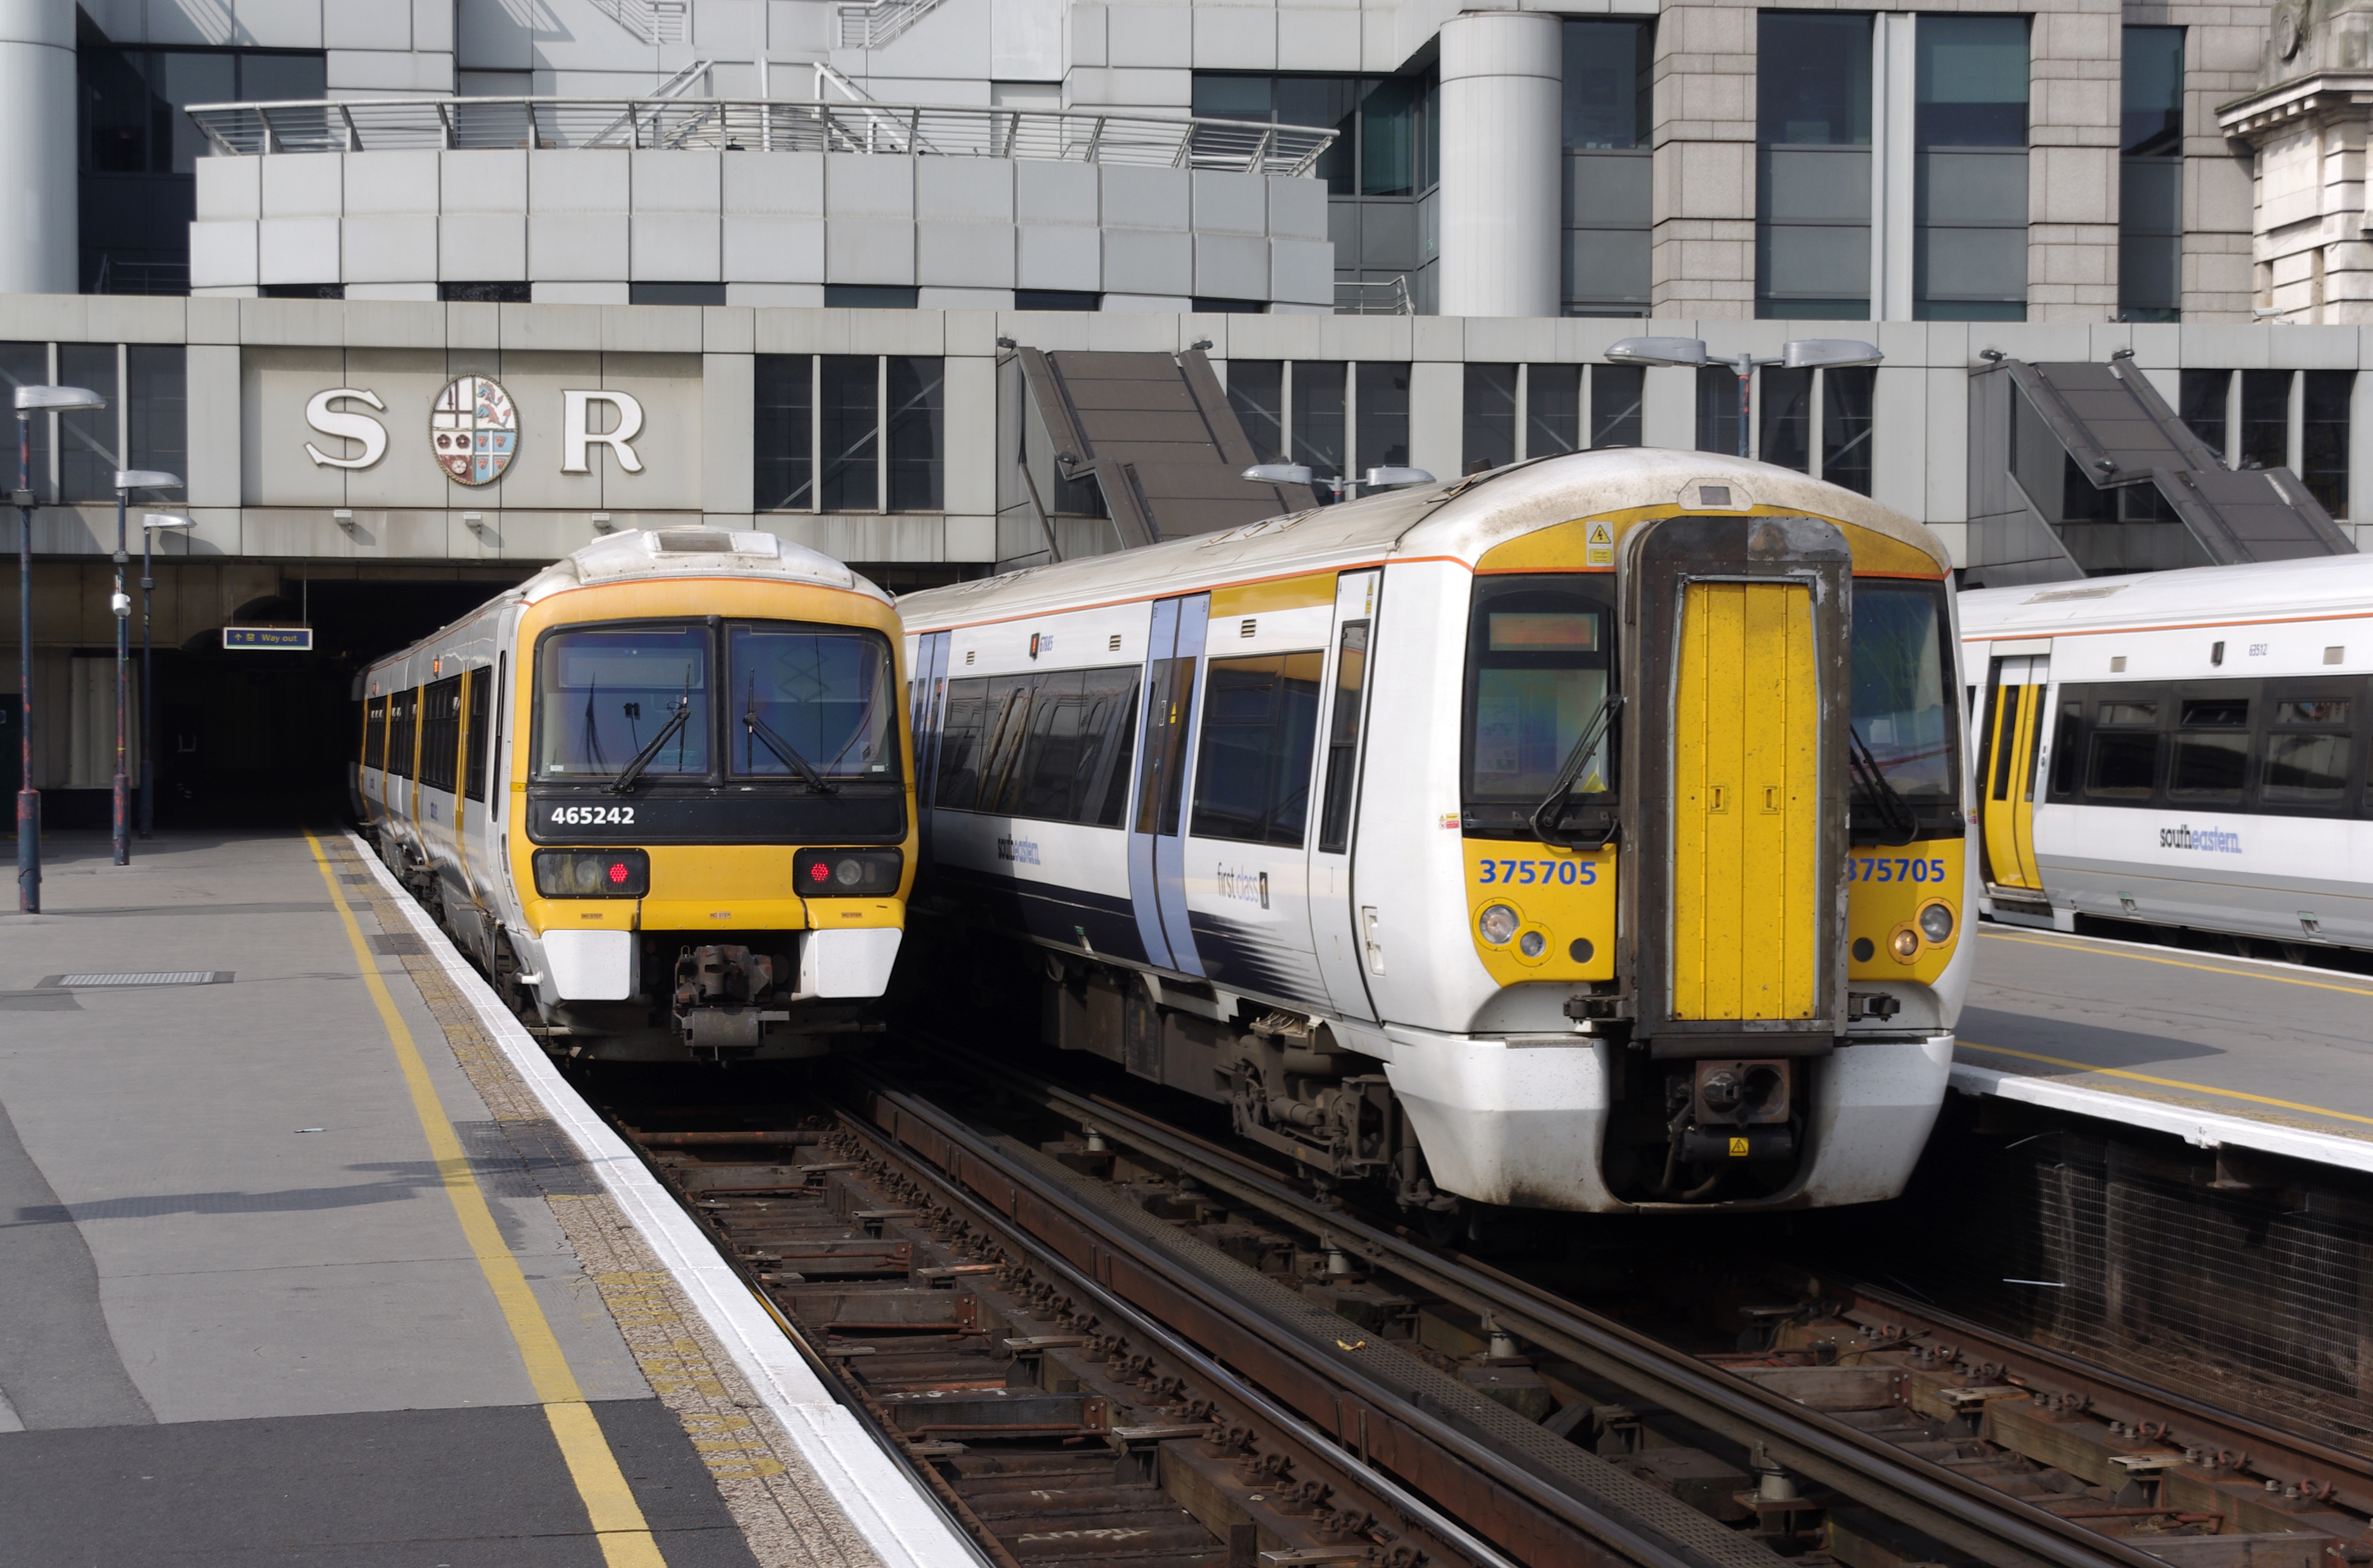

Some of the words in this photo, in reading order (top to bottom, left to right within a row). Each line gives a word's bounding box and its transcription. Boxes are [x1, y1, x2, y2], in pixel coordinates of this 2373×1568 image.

[304, 387, 388, 469] S
[560, 388, 644, 473] R
[261, 634, 280, 643] Way
[2249, 643, 2268, 657] 63512
[551, 806, 635, 825] 465242
[1217, 861, 1236, 899] first
[1236, 865, 1259, 903] class
[1479, 859, 1597, 885] 375705
